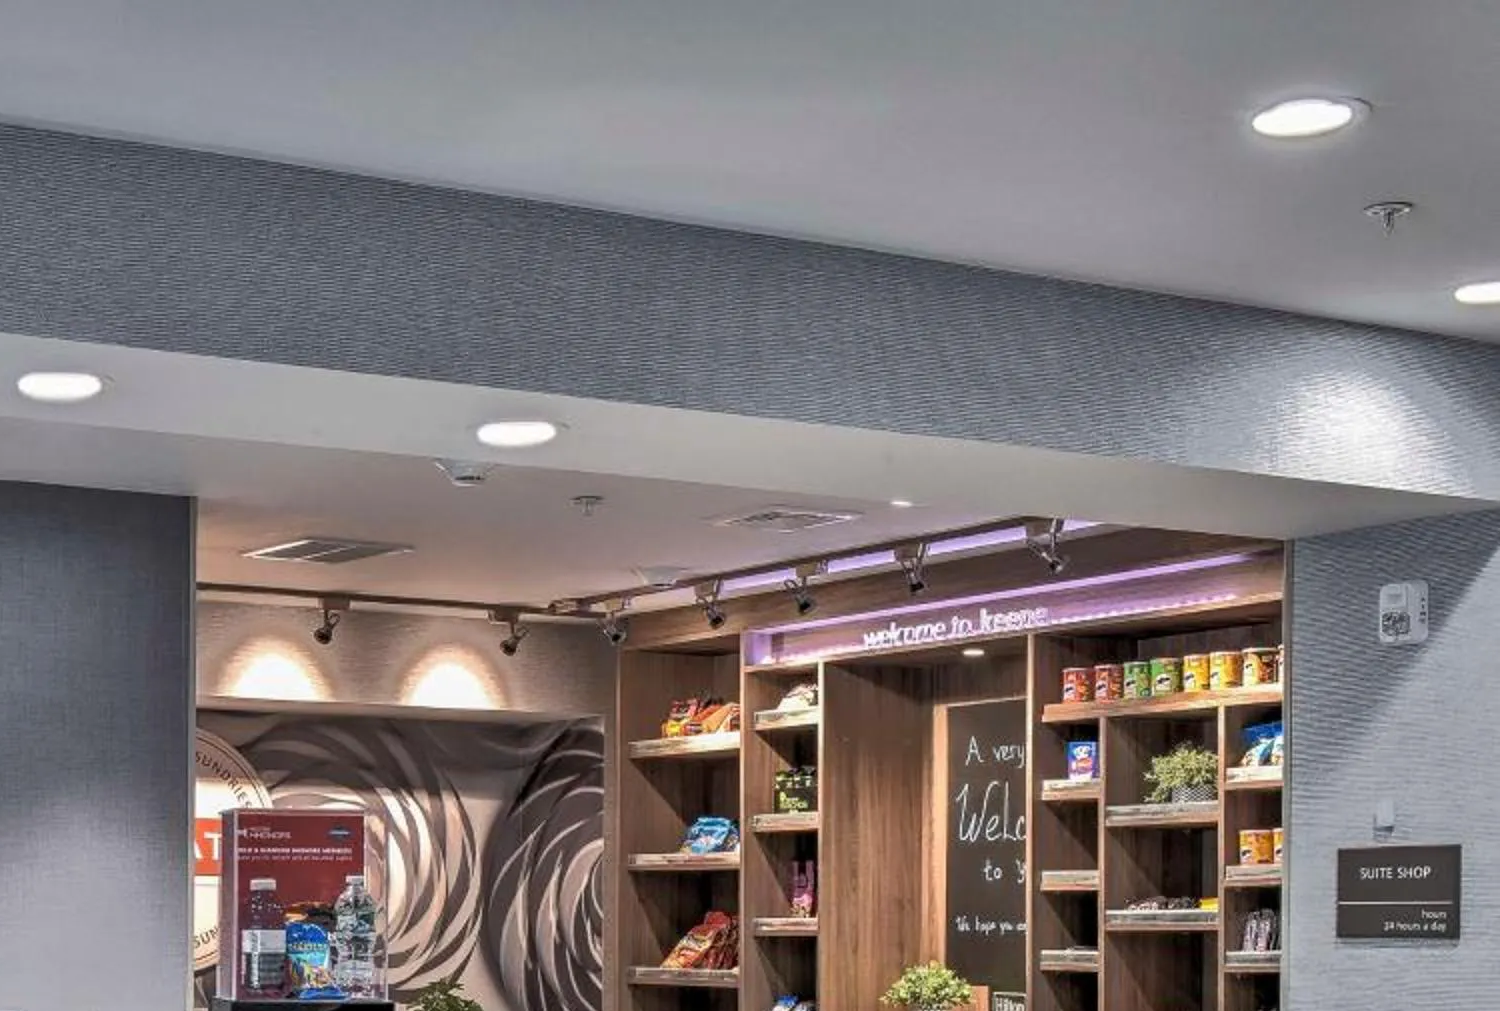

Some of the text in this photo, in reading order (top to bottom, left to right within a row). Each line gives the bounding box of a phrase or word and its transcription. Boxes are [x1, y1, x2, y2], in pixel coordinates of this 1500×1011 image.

[862, 606, 1049, 649] welcome to keene
[965, 735, 1026, 768] A very
[955, 780, 1027, 843] Welc
[983, 859, 1003, 882] to
[1359, 866, 1431, 880] SUITE SHOP
[1421, 909, 1447, 919] hours
[1396, 921, 1421, 931] hours
